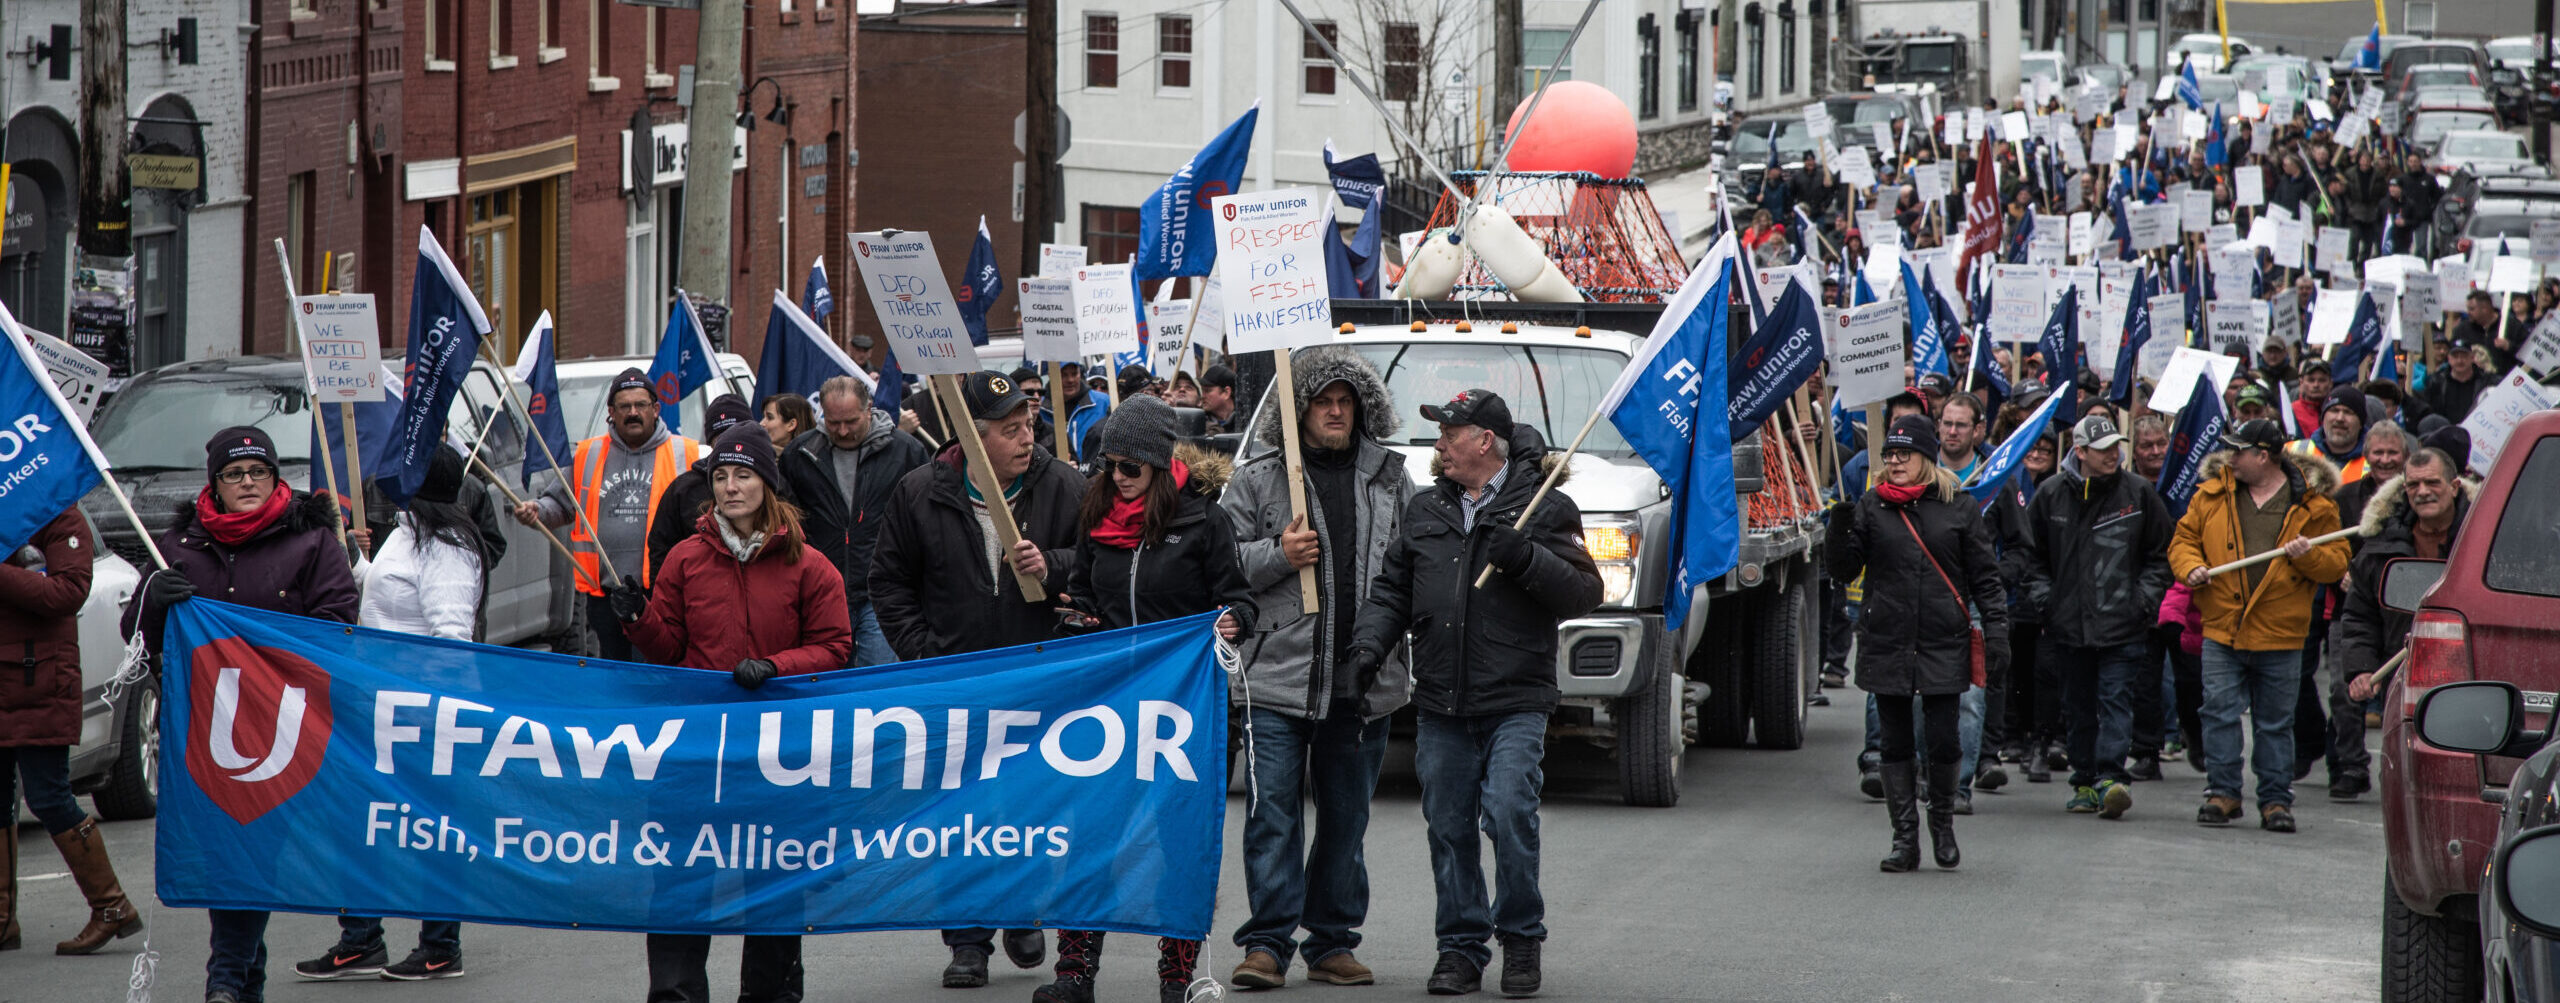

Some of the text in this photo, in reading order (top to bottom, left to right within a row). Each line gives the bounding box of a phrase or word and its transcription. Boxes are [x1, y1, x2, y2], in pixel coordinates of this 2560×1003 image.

[657, 134, 677, 174] the
[130, 158, 195, 176] Duckworth
[145, 173, 177, 186] Hotel
[1161, 193, 1171, 221] Allied
[1239, 203, 1265, 214] FFAW
[1270, 198, 1308, 211] UNIFOR
[1170, 190, 1191, 272] UNIFOR
[1230, 219, 1321, 253] RESPECT
[870, 244, 890, 253] FFAW
[893, 242, 925, 253] UNIFOR
[1160, 222, 1170, 263] Workers
[1251, 253, 1298, 280] FOR
[878, 274, 927, 296] DFO
[1250, 277, 1316, 304] FISH
[315, 303, 335, 311] FFAW
[338, 302, 368, 310] UNIFOR
[883, 300, 943, 317] THREAT
[1032, 304, 1063, 312] COASTAL
[1082, 306, 1128, 318] ENOUGH
[1851, 313, 1870, 323] FFAW
[1873, 305, 1899, 318] UNIFOR
[1024, 316, 1074, 325] COMMUNITIES
[1234, 298, 1331, 337] HARVESTERS
[315, 323, 343, 336] WE
[1036, 329, 1064, 337] MATTER
[1160, 324, 1184, 336] SAVE
[2217, 322, 2245, 332] SAVE
[74, 332, 105, 346] HUFF
[1851, 332, 1890, 346] COASTAL
[2214, 334, 2251, 345] RURAL
[2531, 334, 2559, 358] RURAL
[312, 343, 359, 356] WILL
[434, 336, 461, 376] Workers
[1757, 327, 1812, 381] UNIFOR
[1840, 344, 1902, 363] COMMUNITIES
[35, 343, 59, 360] FFAW
[62, 355, 98, 378] UNIFOR
[329, 360, 351, 371] BE
[1855, 362, 1890, 375] MATTER
[1750, 390, 1768, 409] Food
[1770, 368, 1790, 389] Allied
[1786, 345, 1813, 372] Workers
[1658, 399, 1689, 438] Fish,
[2166, 415, 2222, 500] FFAW UNIFOR
[374, 689, 686, 781] FFAW
[757, 698, 1199, 790] UNIFOR
[365, 801, 1070, 871] Fish, Food & Allied Workers
